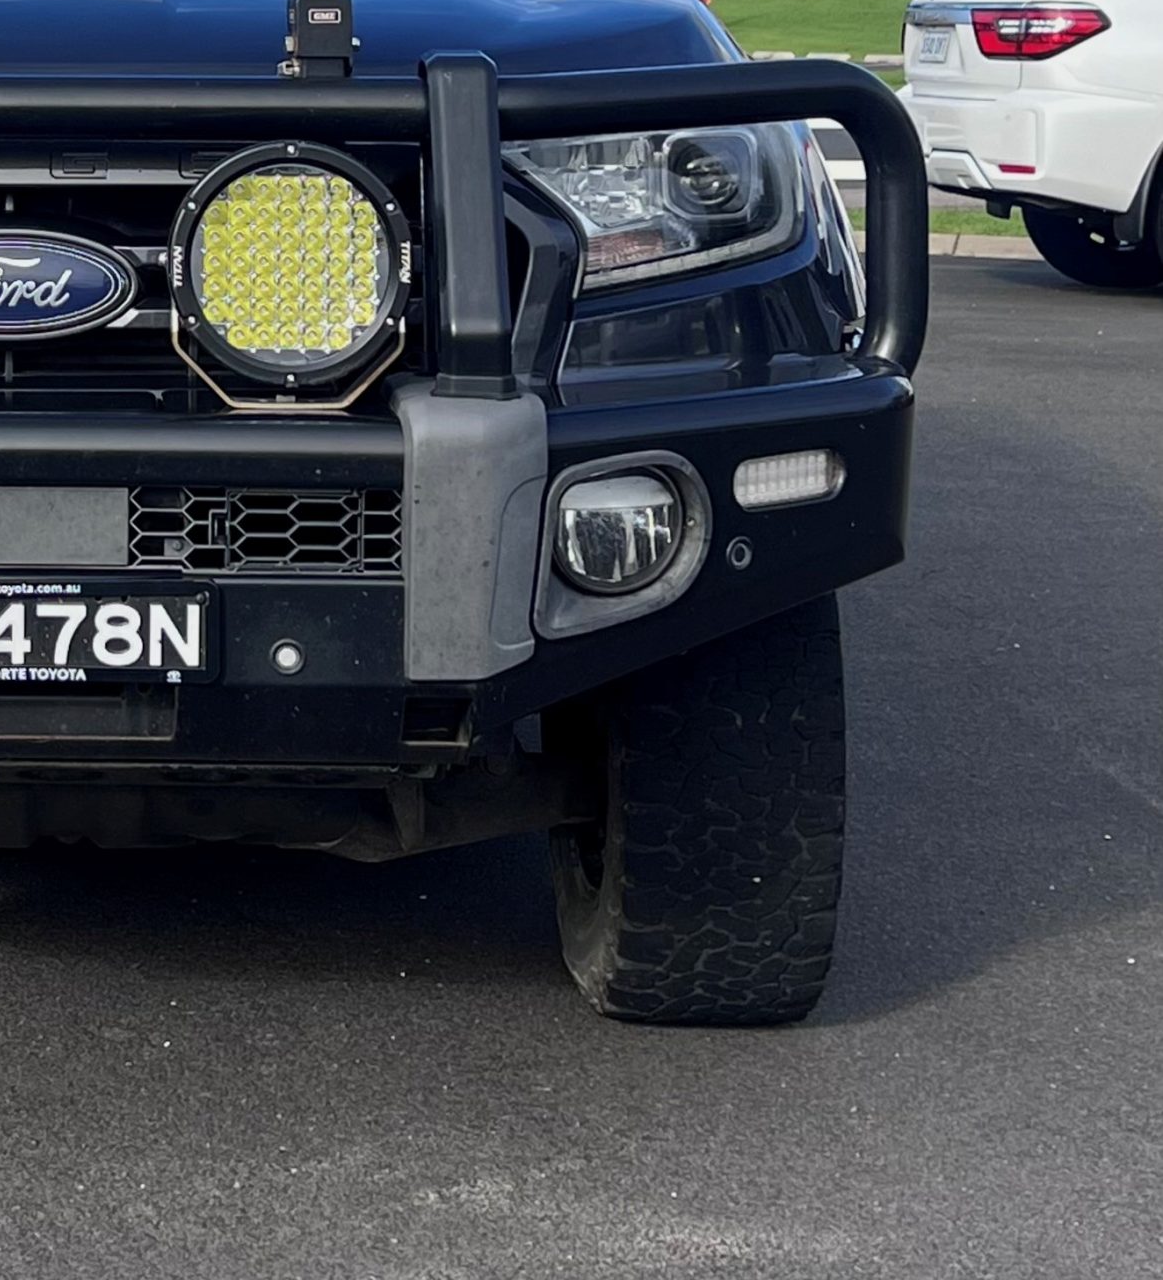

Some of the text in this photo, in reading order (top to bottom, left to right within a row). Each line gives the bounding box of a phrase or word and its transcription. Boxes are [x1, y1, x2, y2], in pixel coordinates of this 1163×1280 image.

[173, 245, 183, 288] TITAN
[400, 241, 411, 284] TITAN
[28, 668, 87, 681] TOYOTA
